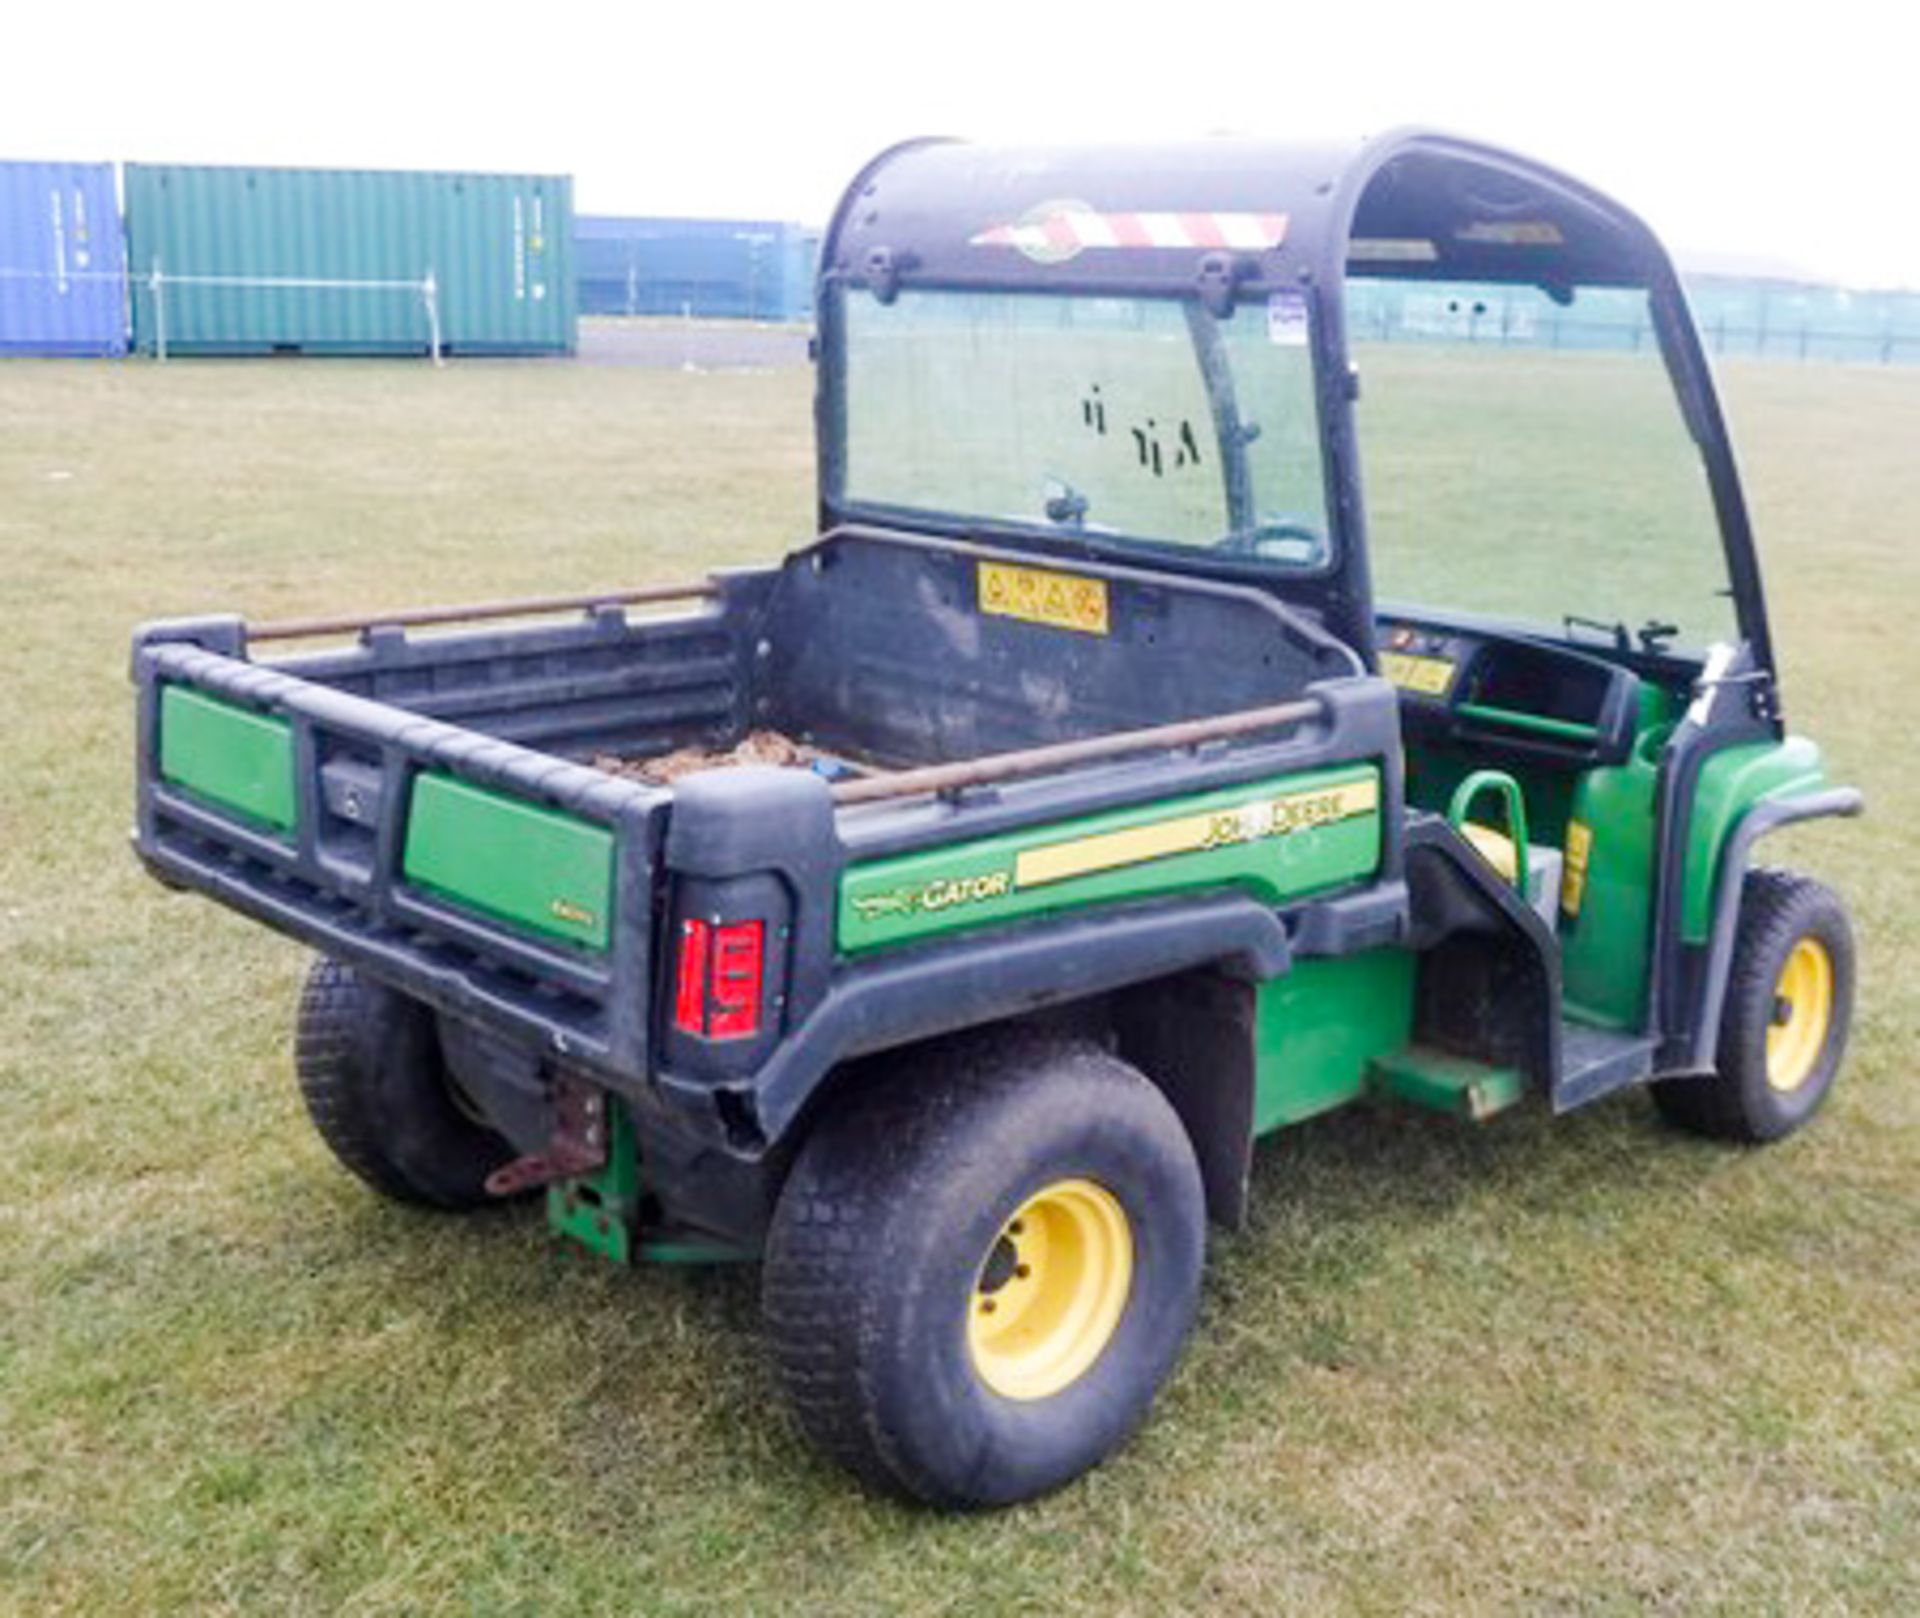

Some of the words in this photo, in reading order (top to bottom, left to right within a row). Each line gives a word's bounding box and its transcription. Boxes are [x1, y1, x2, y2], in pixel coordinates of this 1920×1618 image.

[1200, 808, 1266, 848] JO
[1271, 793, 1344, 834] DEERE
[922, 871, 1009, 911] GATOR
